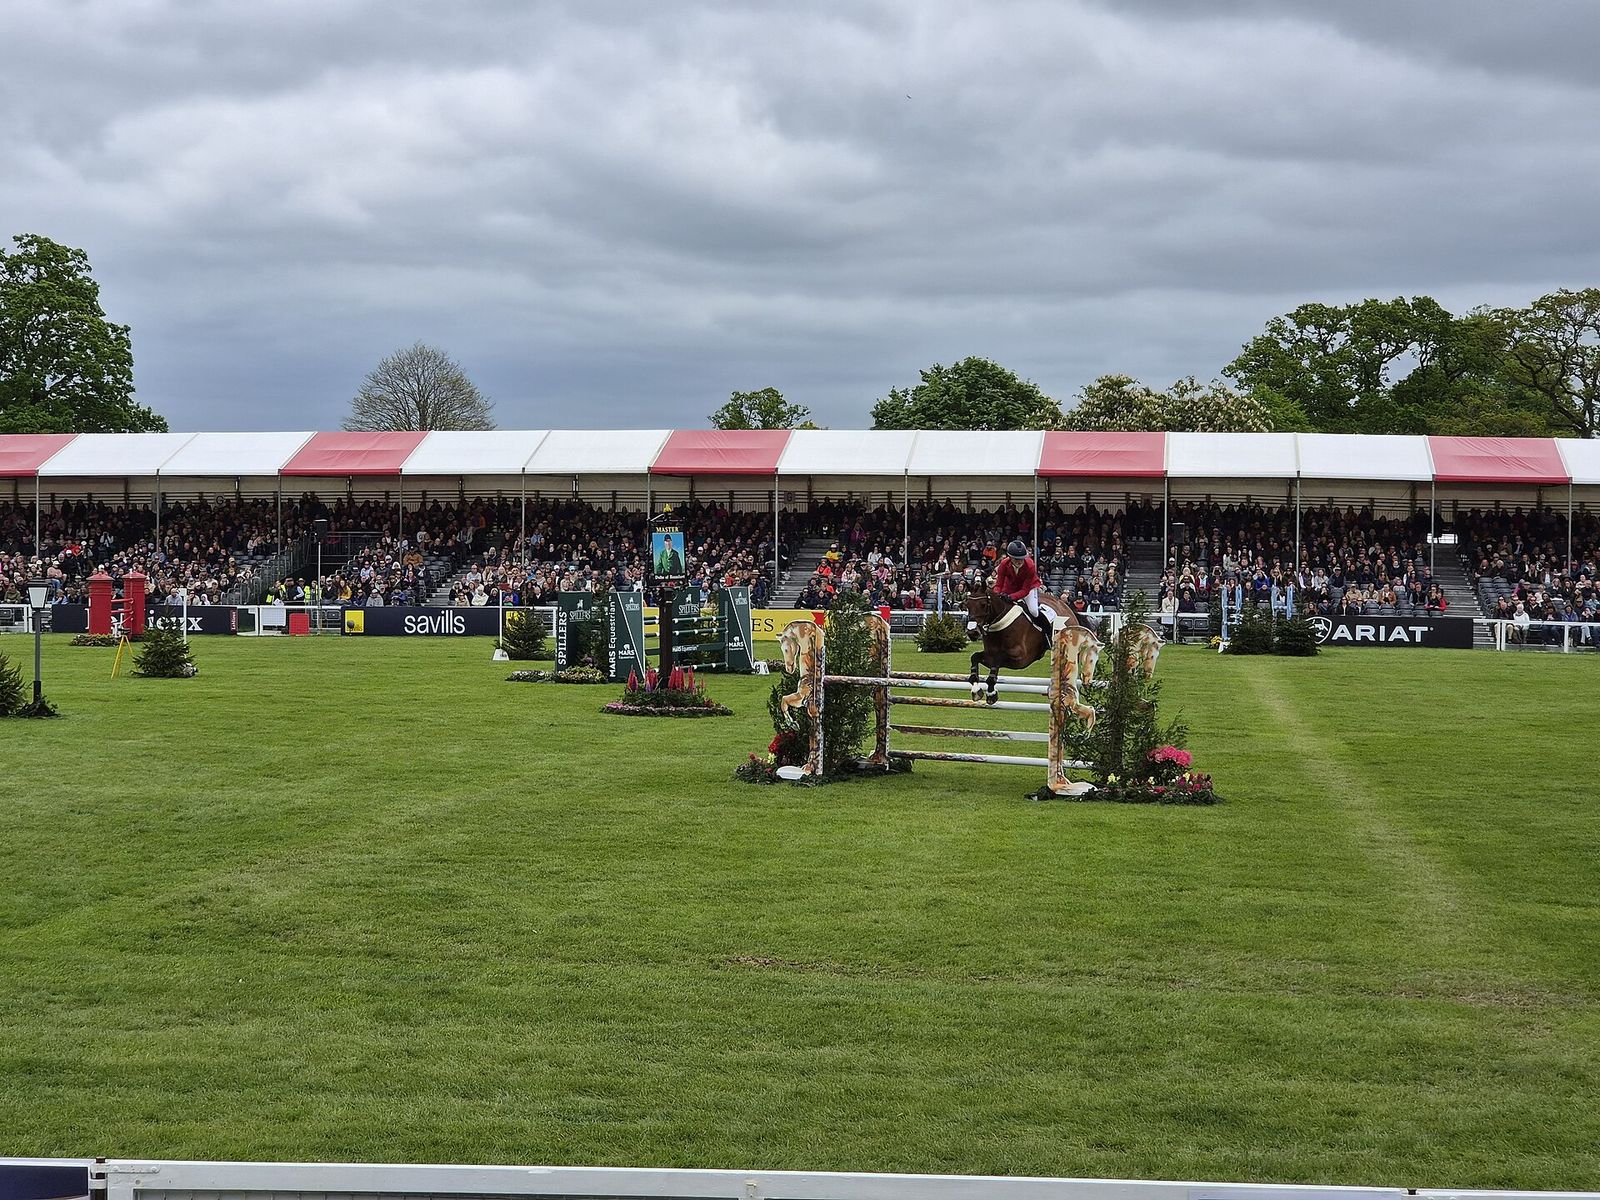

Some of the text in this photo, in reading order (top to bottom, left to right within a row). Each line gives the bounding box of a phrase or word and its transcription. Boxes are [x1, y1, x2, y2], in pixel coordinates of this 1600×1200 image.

[404, 610, 466, 634] savills
[752, 618, 774, 632] ES
[608, 650, 616, 678] MARS
